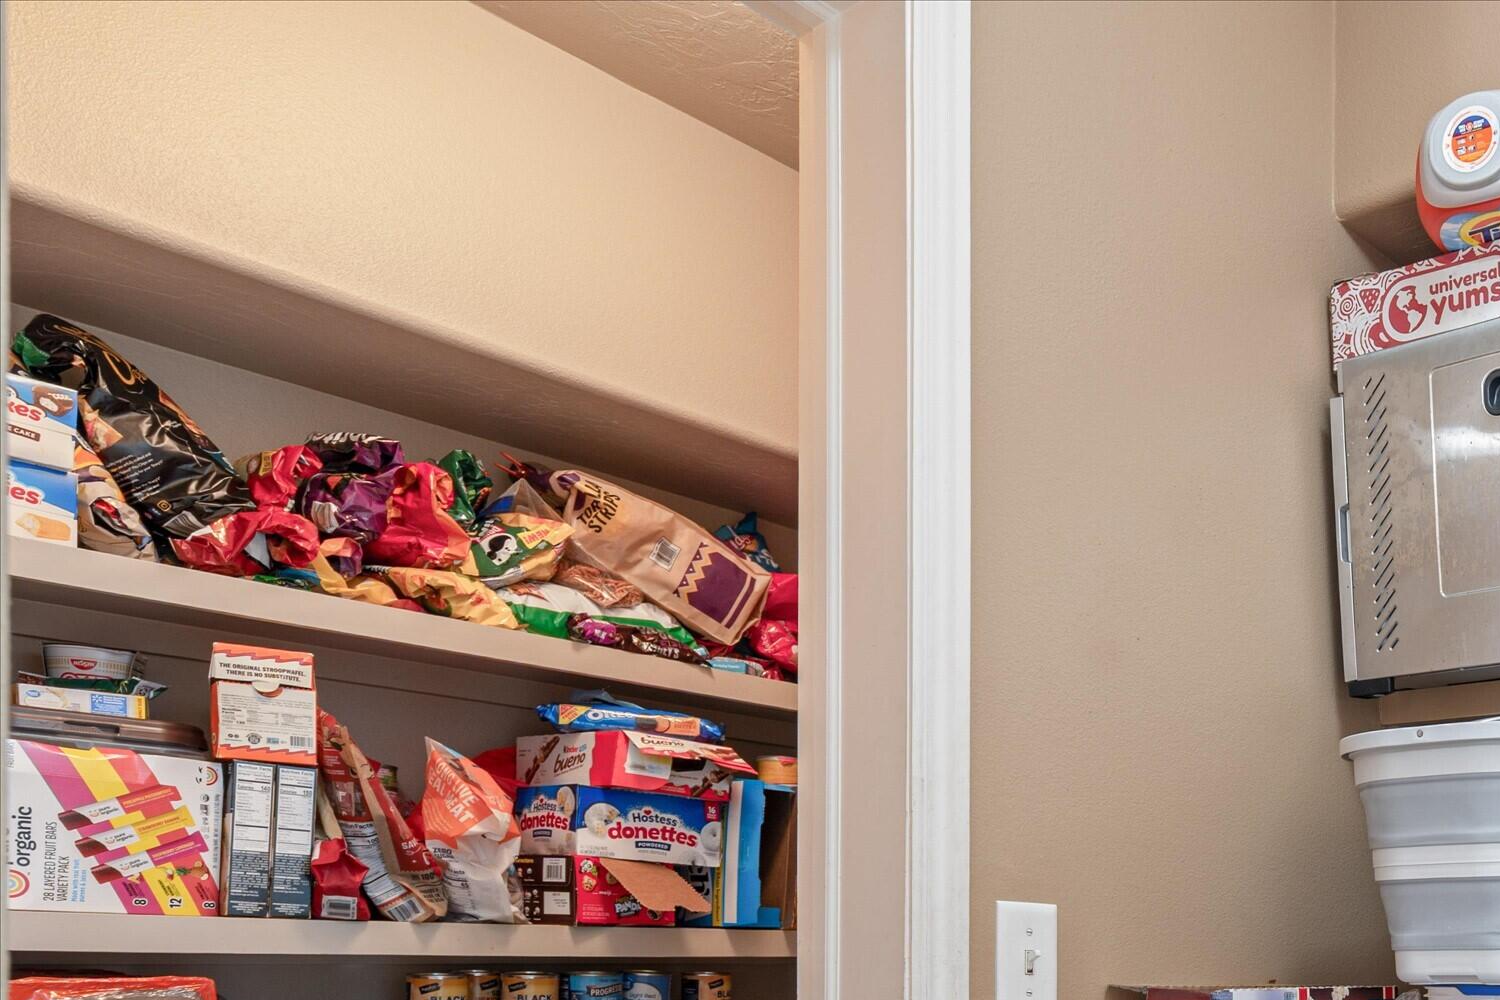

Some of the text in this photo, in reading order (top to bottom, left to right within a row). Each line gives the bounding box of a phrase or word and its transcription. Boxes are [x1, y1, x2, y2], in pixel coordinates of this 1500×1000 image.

[588, 494, 621, 533] STRIPS
[232, 663, 261, 672] ORIGINAL
[640, 736, 685, 748] bueno
[553, 752, 586, 774] bueno
[533, 803, 556, 812] Hostess
[520, 814, 569, 831] donettes
[632, 813, 678, 827] Hostess
[16, 806, 36, 867] organic
[607, 822, 698, 848] donettes
[43, 821, 57, 901] 28 LAYERED FRUIT BARS
[56, 855, 70, 902] VARIETY PACK
[170, 897, 182, 907] 12
